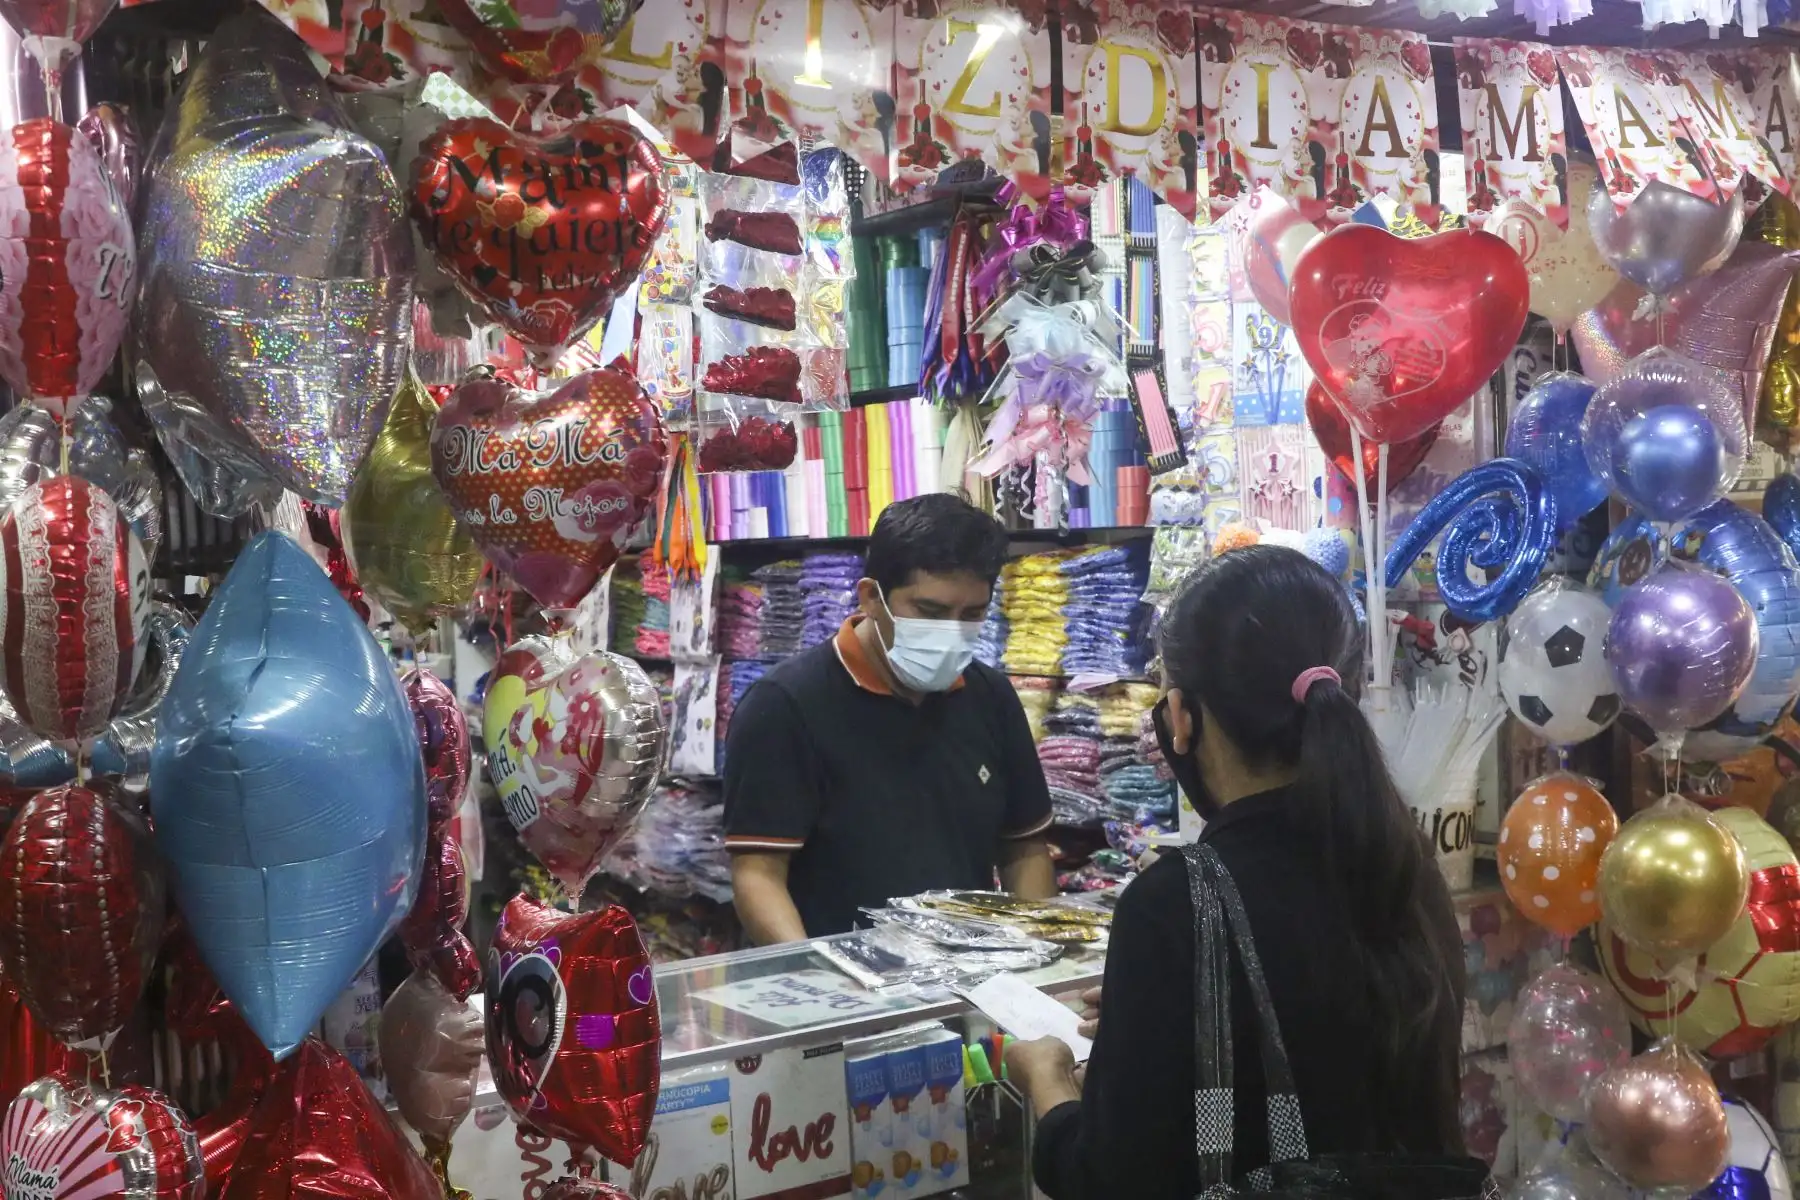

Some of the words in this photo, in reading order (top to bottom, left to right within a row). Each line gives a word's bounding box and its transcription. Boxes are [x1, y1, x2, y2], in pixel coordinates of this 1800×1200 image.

[1331, 273, 1386, 300] Feliz
[1257, 325, 1274, 347] 9
[1268, 453, 1279, 473] 1
[464, 510, 486, 525] es
[489, 492, 517, 524] la
[523, 488, 628, 527] Mejor
[748, 1091, 837, 1174] love
[5, 1154, 58, 1190] Mamá
